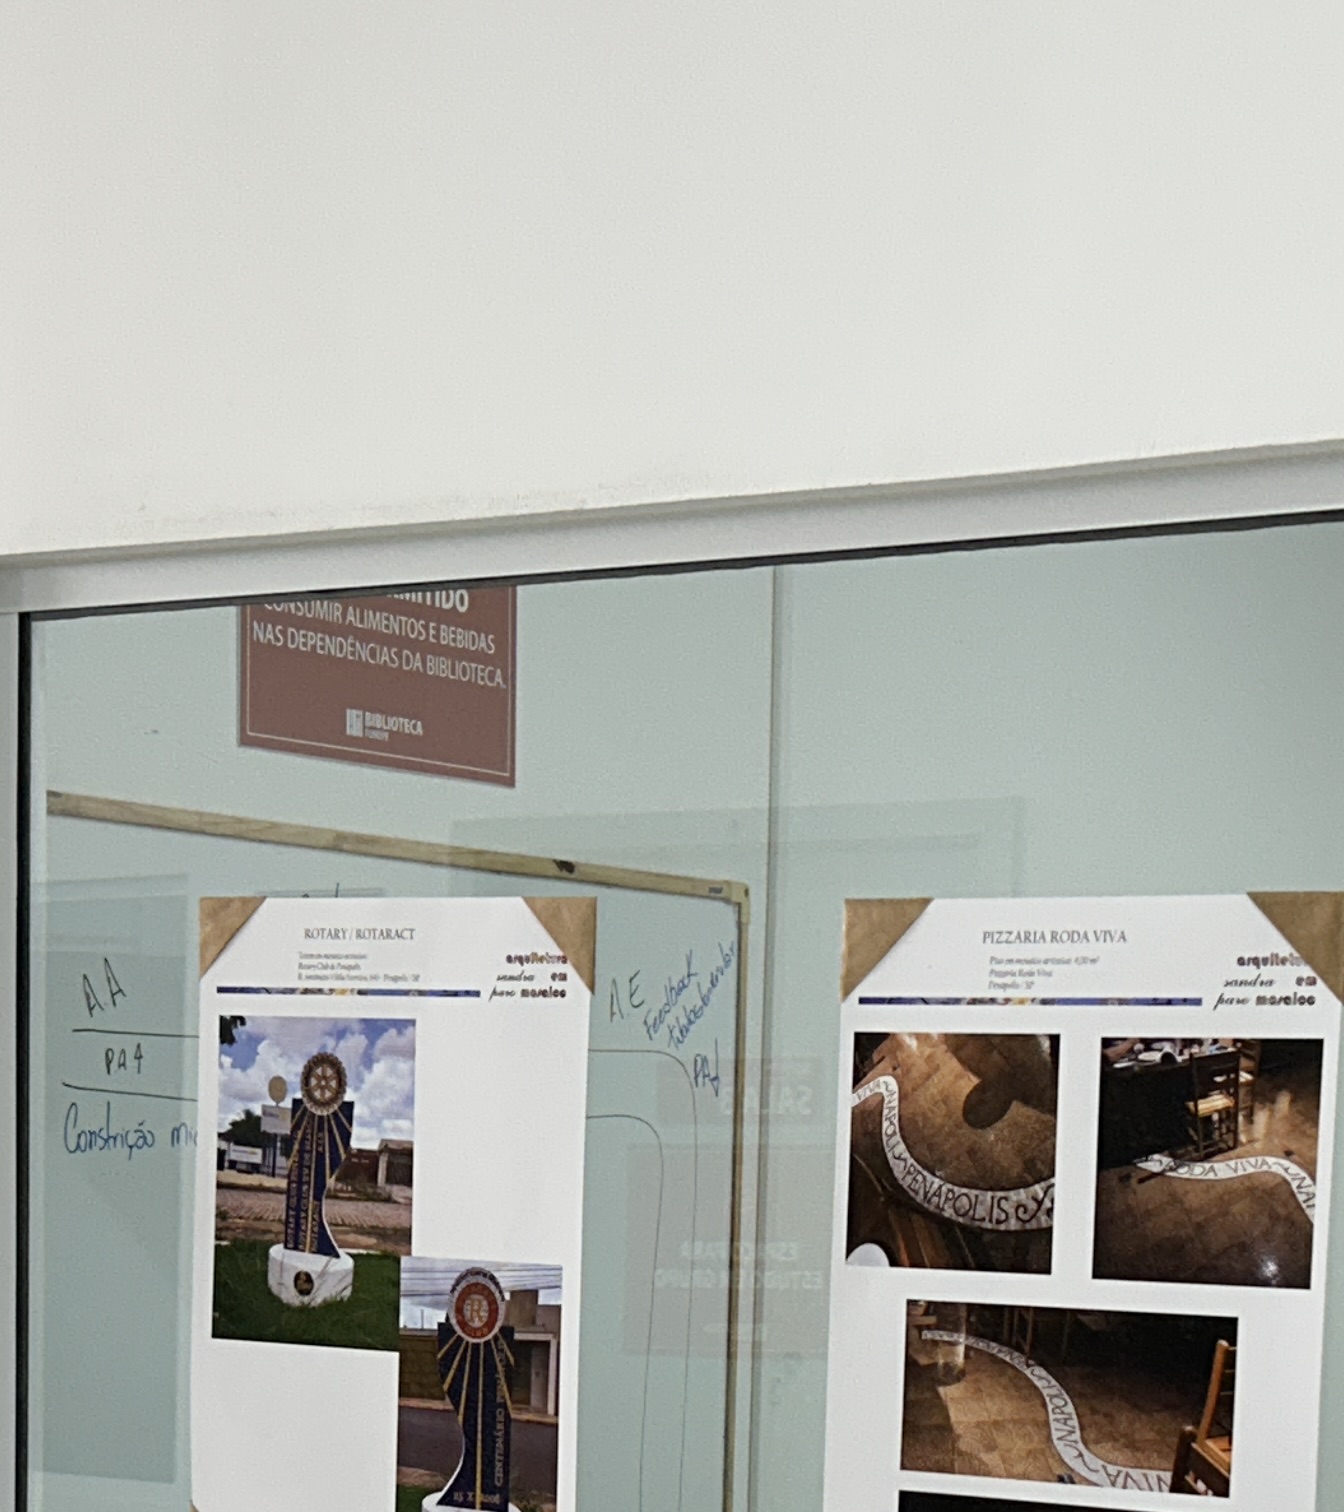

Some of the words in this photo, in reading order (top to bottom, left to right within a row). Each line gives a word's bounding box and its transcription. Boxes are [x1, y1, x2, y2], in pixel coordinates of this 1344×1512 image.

[345, 606, 426, 641] ALIMENTOS
[429, 621, 437, 643] E
[439, 624, 496, 655] BEBIDAS
[253, 619, 284, 647] NAS
[287, 626, 399, 669] DEPENDÊNCIAS
[402, 649, 423, 673] DA
[365, 711, 423, 736] BIBLIOTECA
[304, 928, 347, 940] ROTARY
[356, 928, 416, 940] ROTARACT
[982, 930, 1047, 944] PIZZARIA
[1050, 929, 1090, 944] RODA
[1093, 929, 1127, 944] VIVA
[1226, 1157, 1272, 1175] VIVA
[901, 1163, 1009, 1225] PENÁPOLIS
